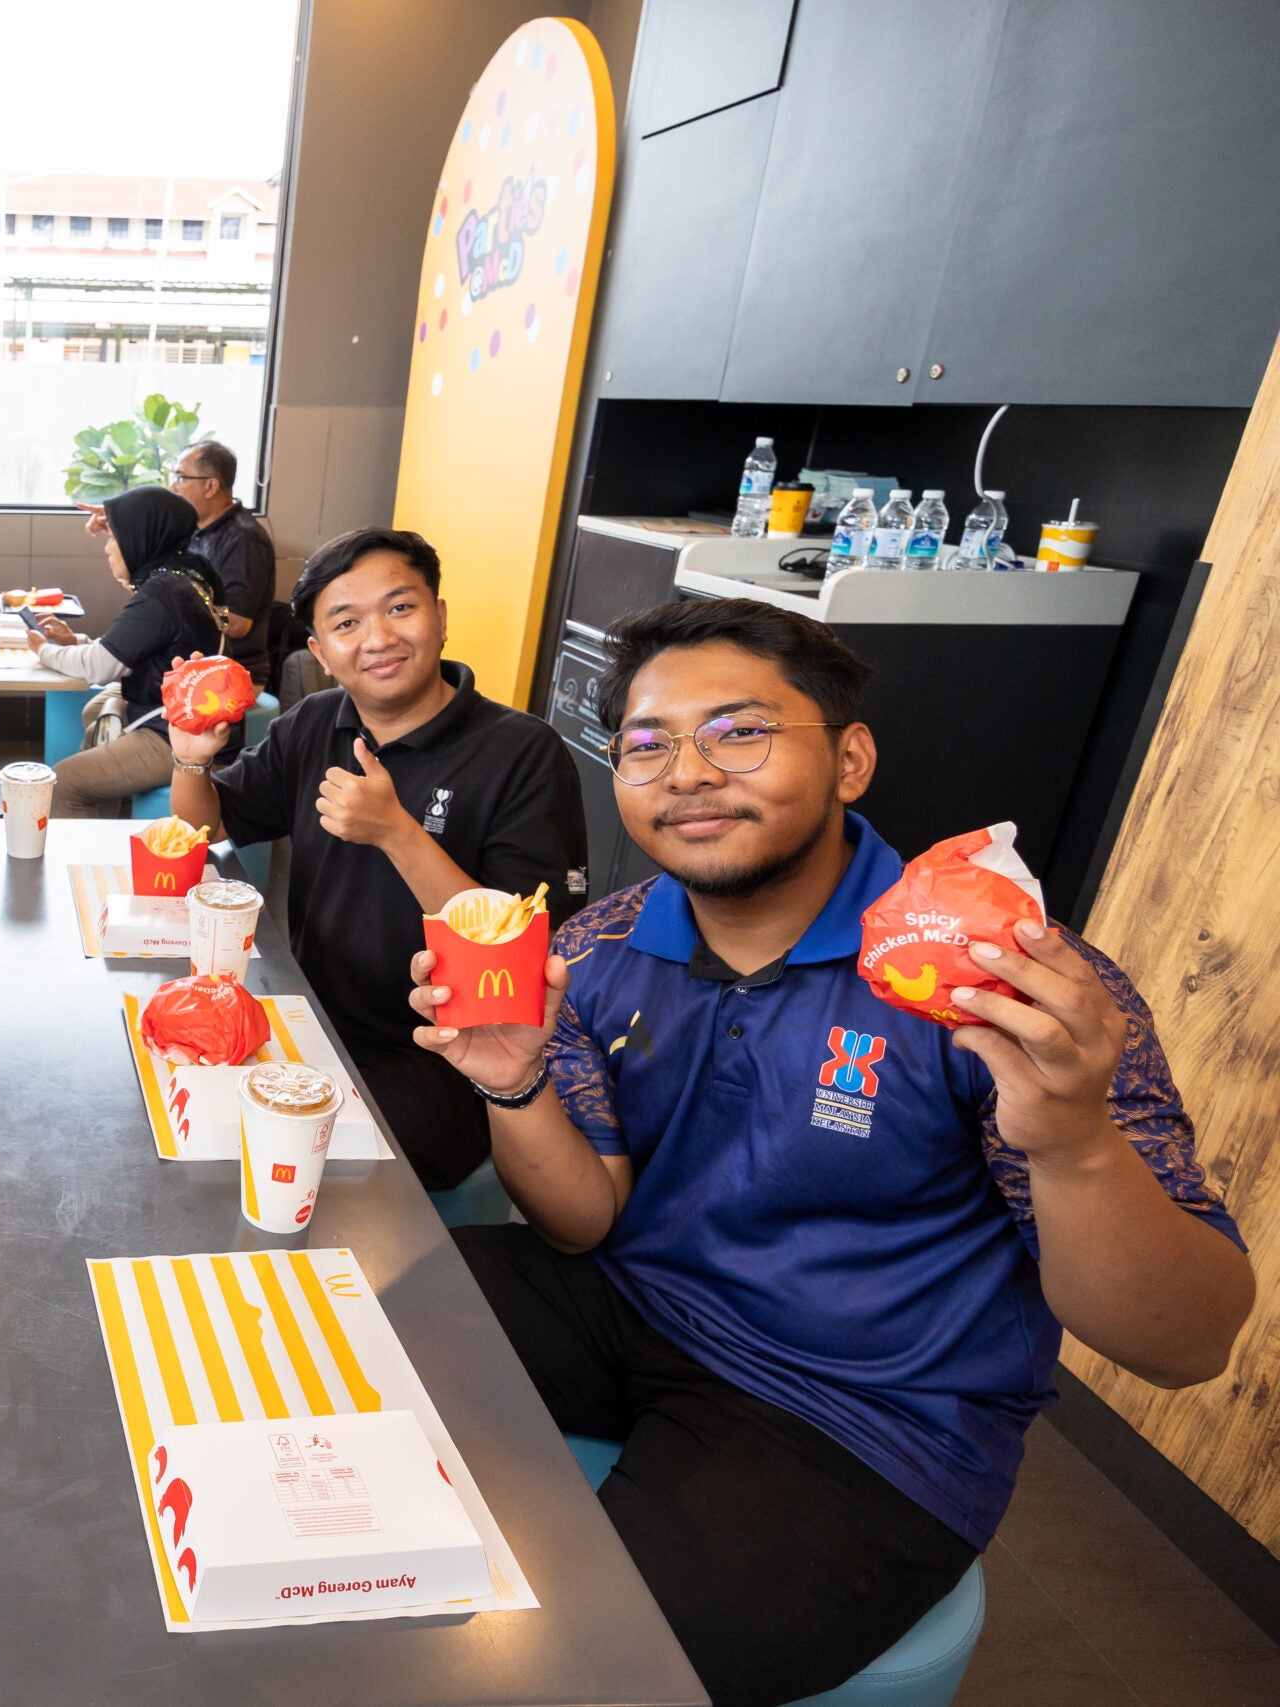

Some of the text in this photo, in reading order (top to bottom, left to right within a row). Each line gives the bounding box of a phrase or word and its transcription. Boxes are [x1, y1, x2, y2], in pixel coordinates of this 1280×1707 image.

[904, 910, 961, 931] Spicy
[923, 928, 970, 947] McD
[815, 1087, 875, 1111] UNIVERSITI
[812, 1102, 873, 1125] MALAYSIA
[810, 1115, 871, 1139] KELANTAN
[318, 1579, 372, 1594] Goreng
[376, 1574, 417, 1589] Ayam
